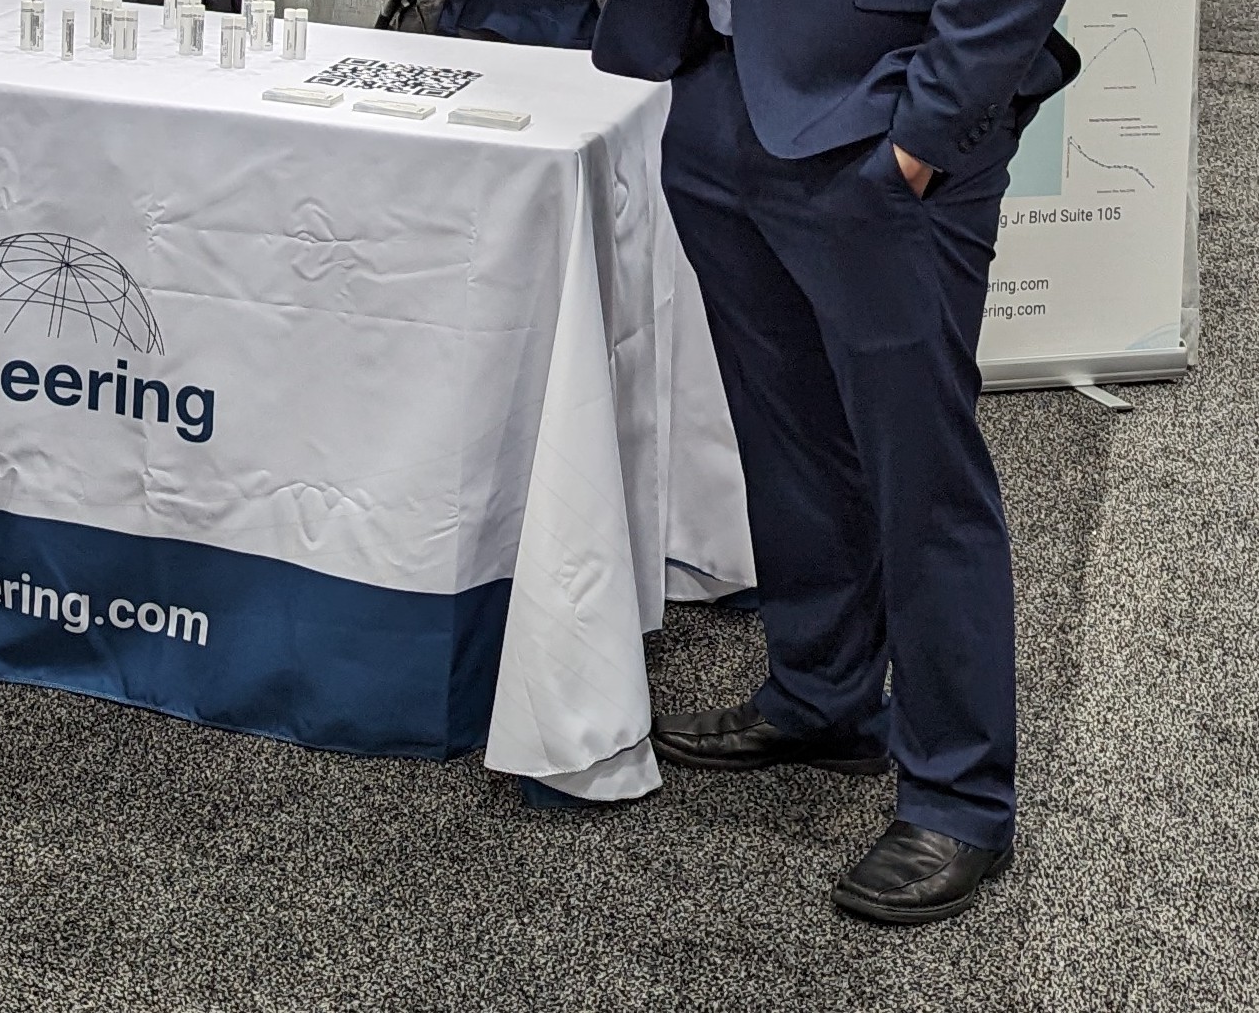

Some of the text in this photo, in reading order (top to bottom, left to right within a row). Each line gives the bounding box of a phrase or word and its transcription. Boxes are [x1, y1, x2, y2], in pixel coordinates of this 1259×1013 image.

[1011, 211, 1025, 225] Jr
[1029, 209, 1056, 224] Blvd
[1060, 208, 1093, 222] Suite
[1097, 207, 1121, 221] 105
